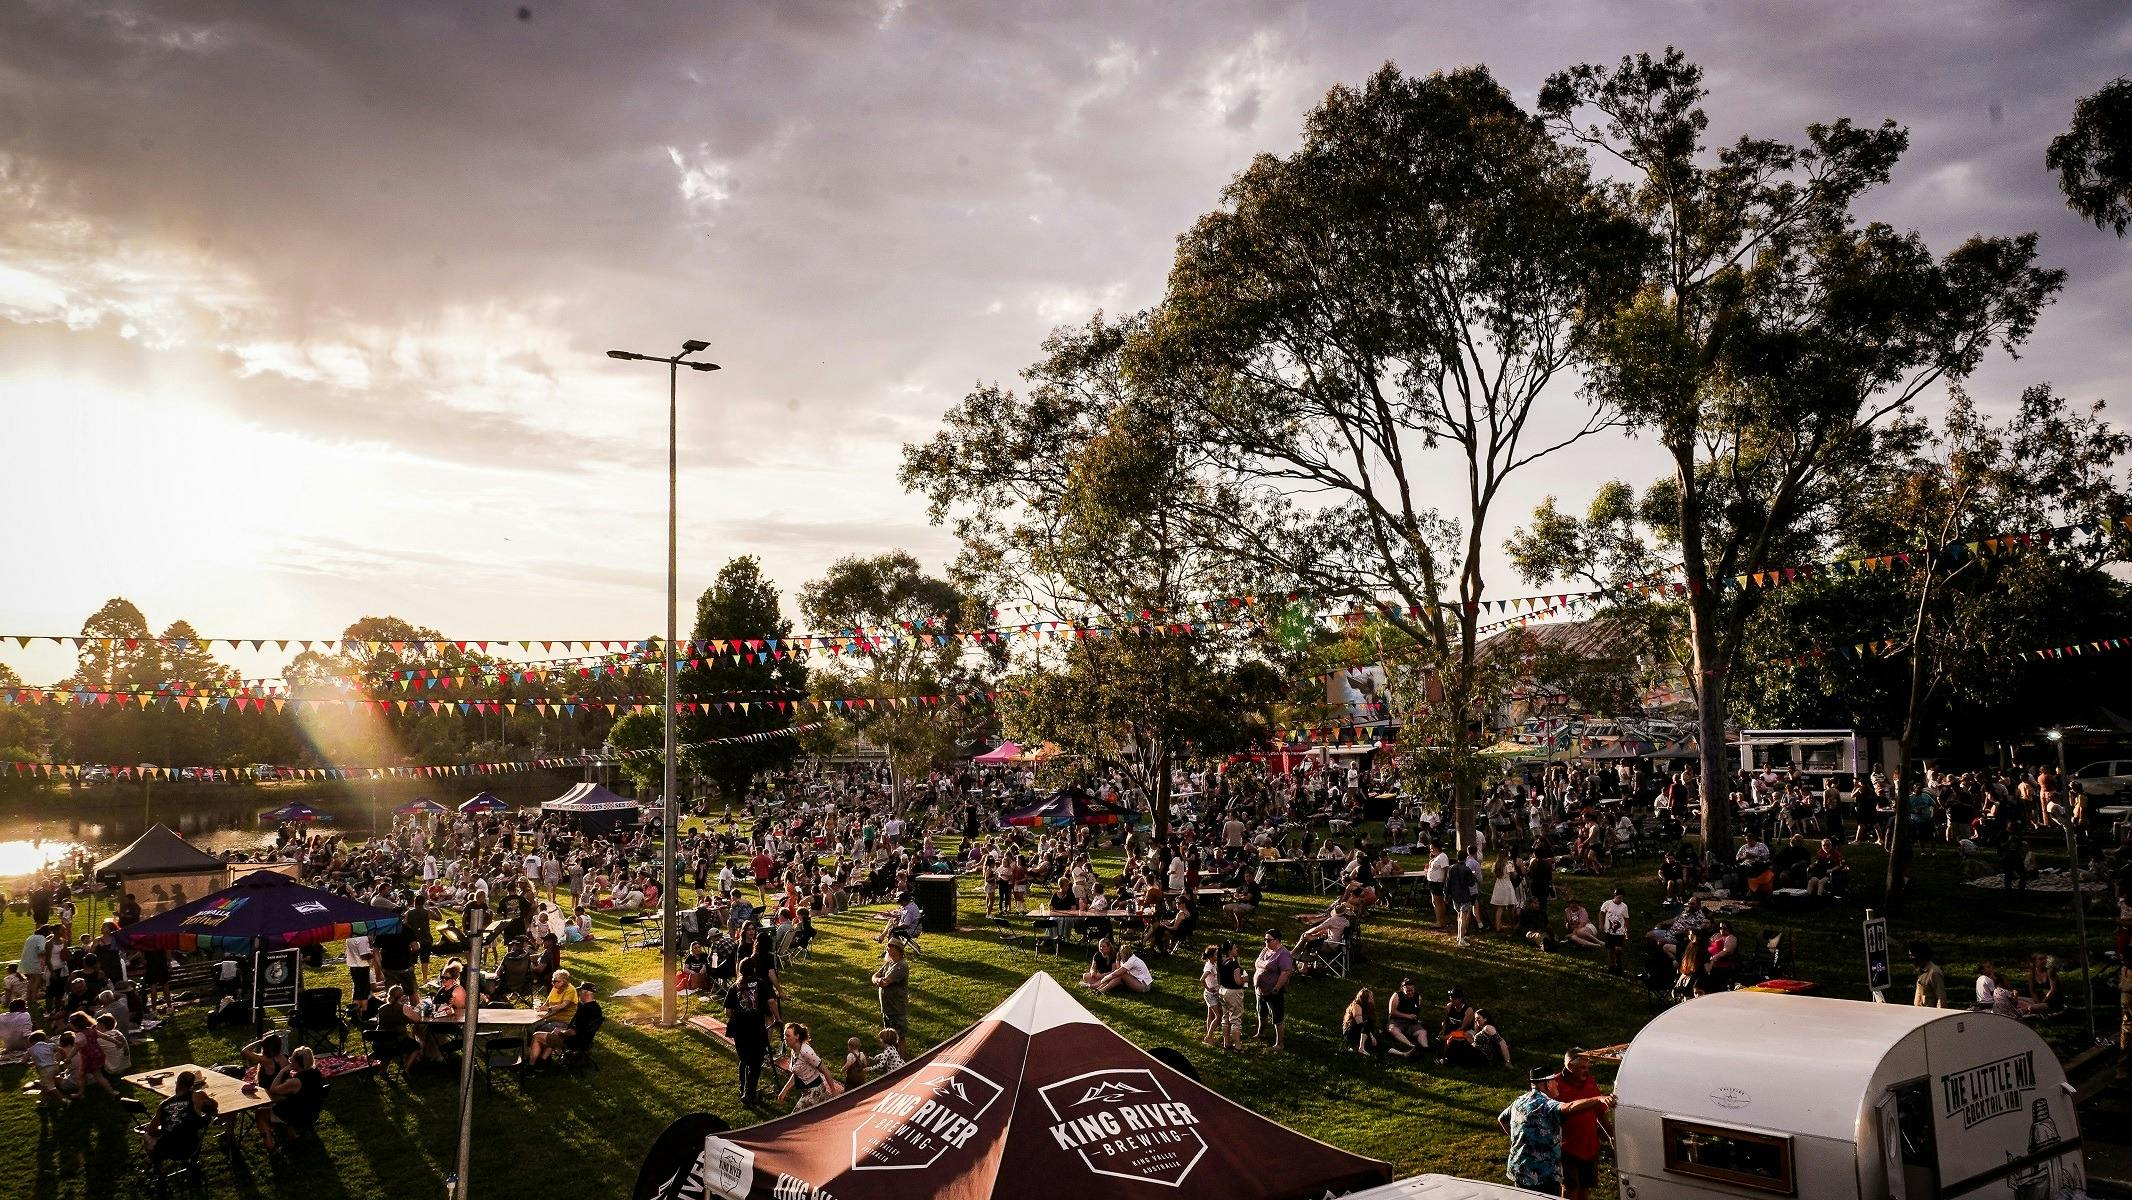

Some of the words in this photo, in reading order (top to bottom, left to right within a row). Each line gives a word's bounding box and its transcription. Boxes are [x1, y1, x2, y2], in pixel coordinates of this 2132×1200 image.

[1969, 1062, 2012, 1100] LITTLE
[2014, 1050, 2036, 1087] MIX
[872, 1091, 922, 1117] KING
[909, 1099, 979, 1149] RIVER
[1966, 1096, 2003, 1124] COCKTAIL
[2004, 1090, 2020, 1109] VAN
[874, 1118, 932, 1150] BREWING
[1049, 1112, 1121, 1150] KING
[1118, 1102, 1200, 1131] RIVER
[1103, 1130, 1182, 1156] BREWING
[1131, 1157, 1150, 1167] KING
[1151, 1152, 1177, 1161] VALLEY
[1142, 1161, 1181, 1174] AUSTRALIA
